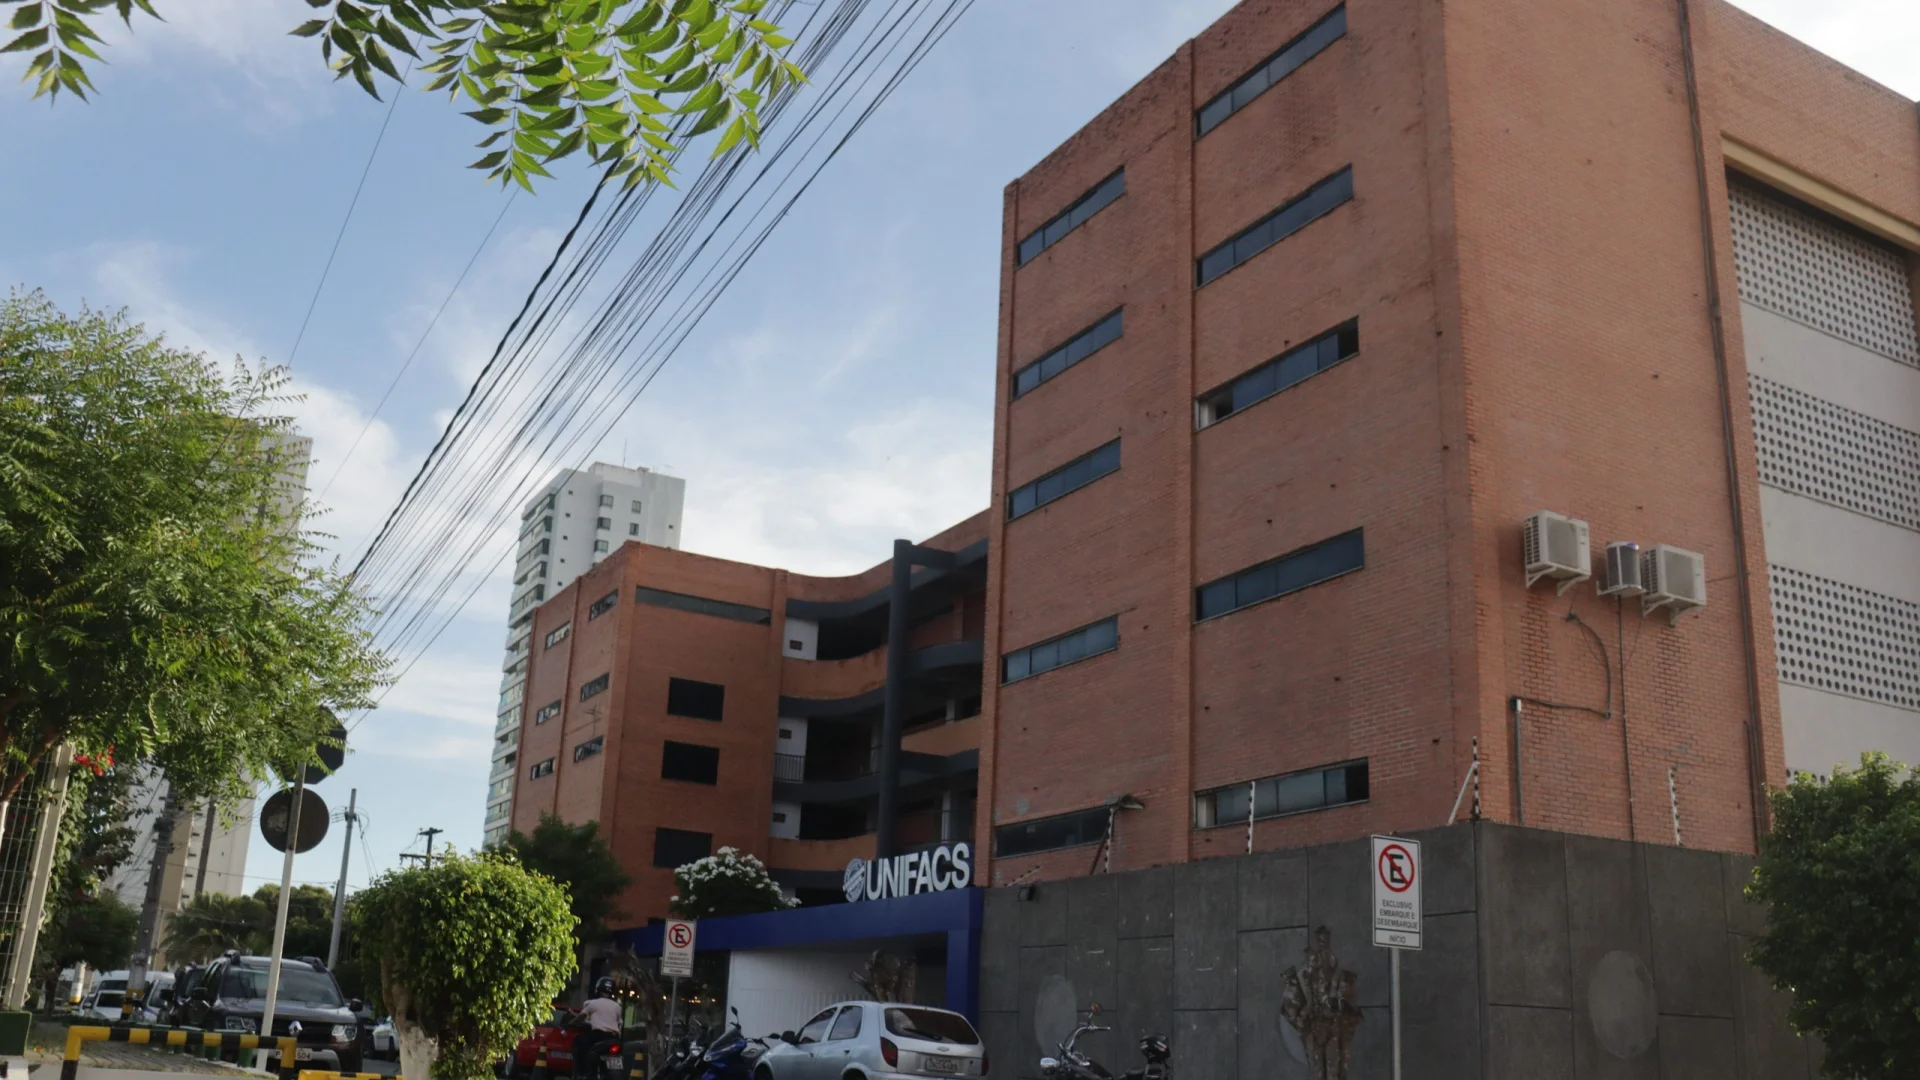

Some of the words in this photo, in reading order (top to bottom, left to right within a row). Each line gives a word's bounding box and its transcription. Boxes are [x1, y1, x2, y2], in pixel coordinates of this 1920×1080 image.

[866, 842, 970, 900] UNIFACS
[1382, 899, 1412, 910] EXCLUSIVO
[1380, 909, 1410, 919] EMBARQUE
[1411, 912, 1415, 920] E
[1376, 917, 1418, 930] DESEMBARQUE
